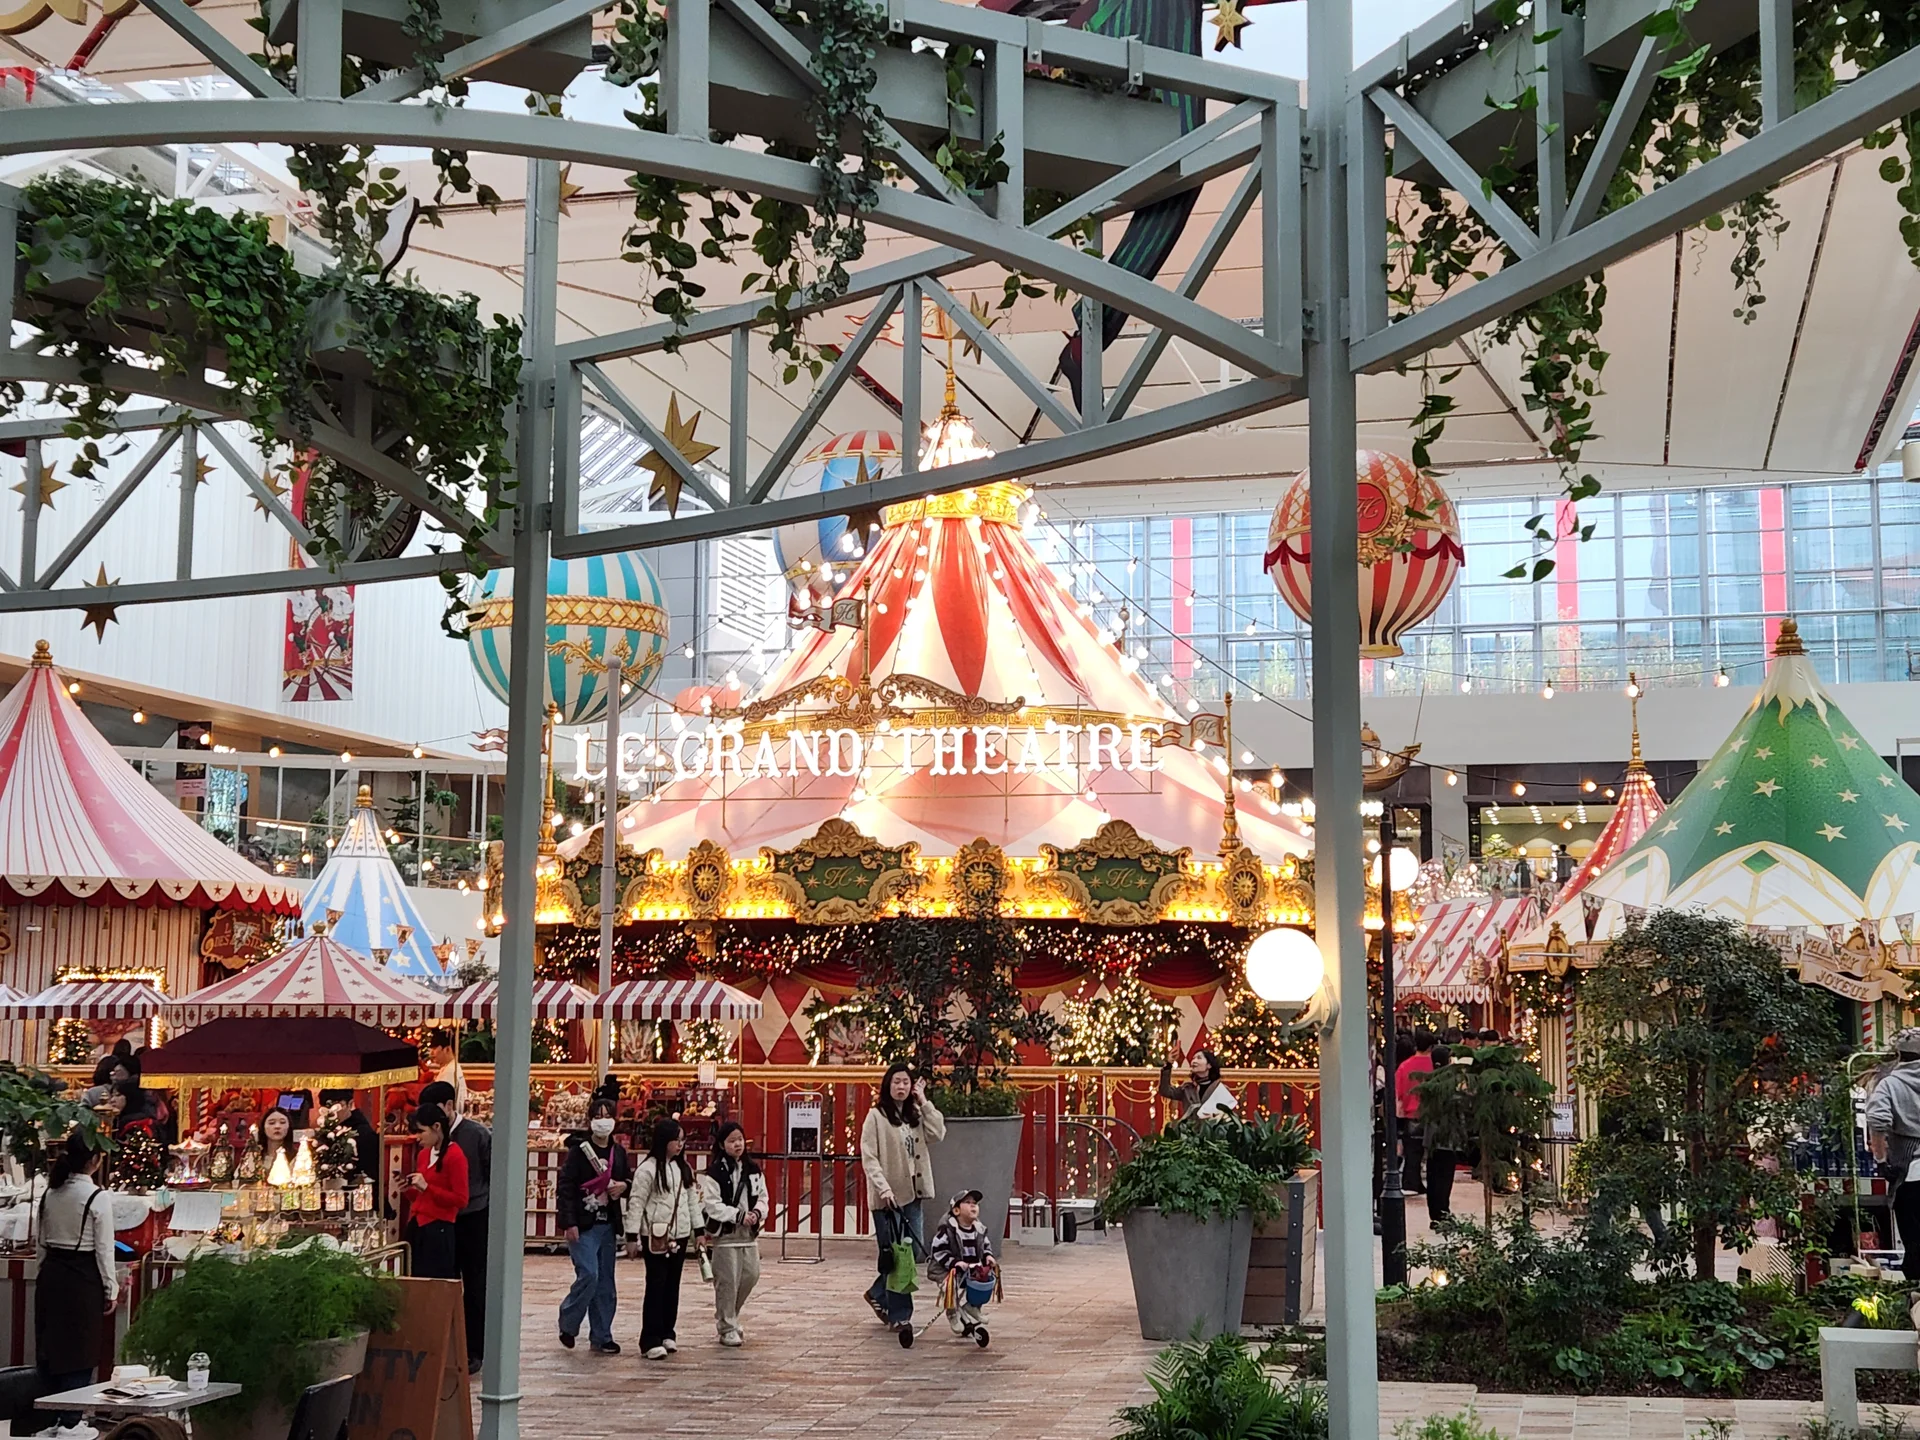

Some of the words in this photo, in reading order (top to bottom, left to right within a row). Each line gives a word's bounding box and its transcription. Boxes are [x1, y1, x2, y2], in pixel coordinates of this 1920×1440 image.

[573, 731, 648, 781] LE
[672, 728, 863, 780] GRAND
[889, 723, 1165, 777] THEATRE
